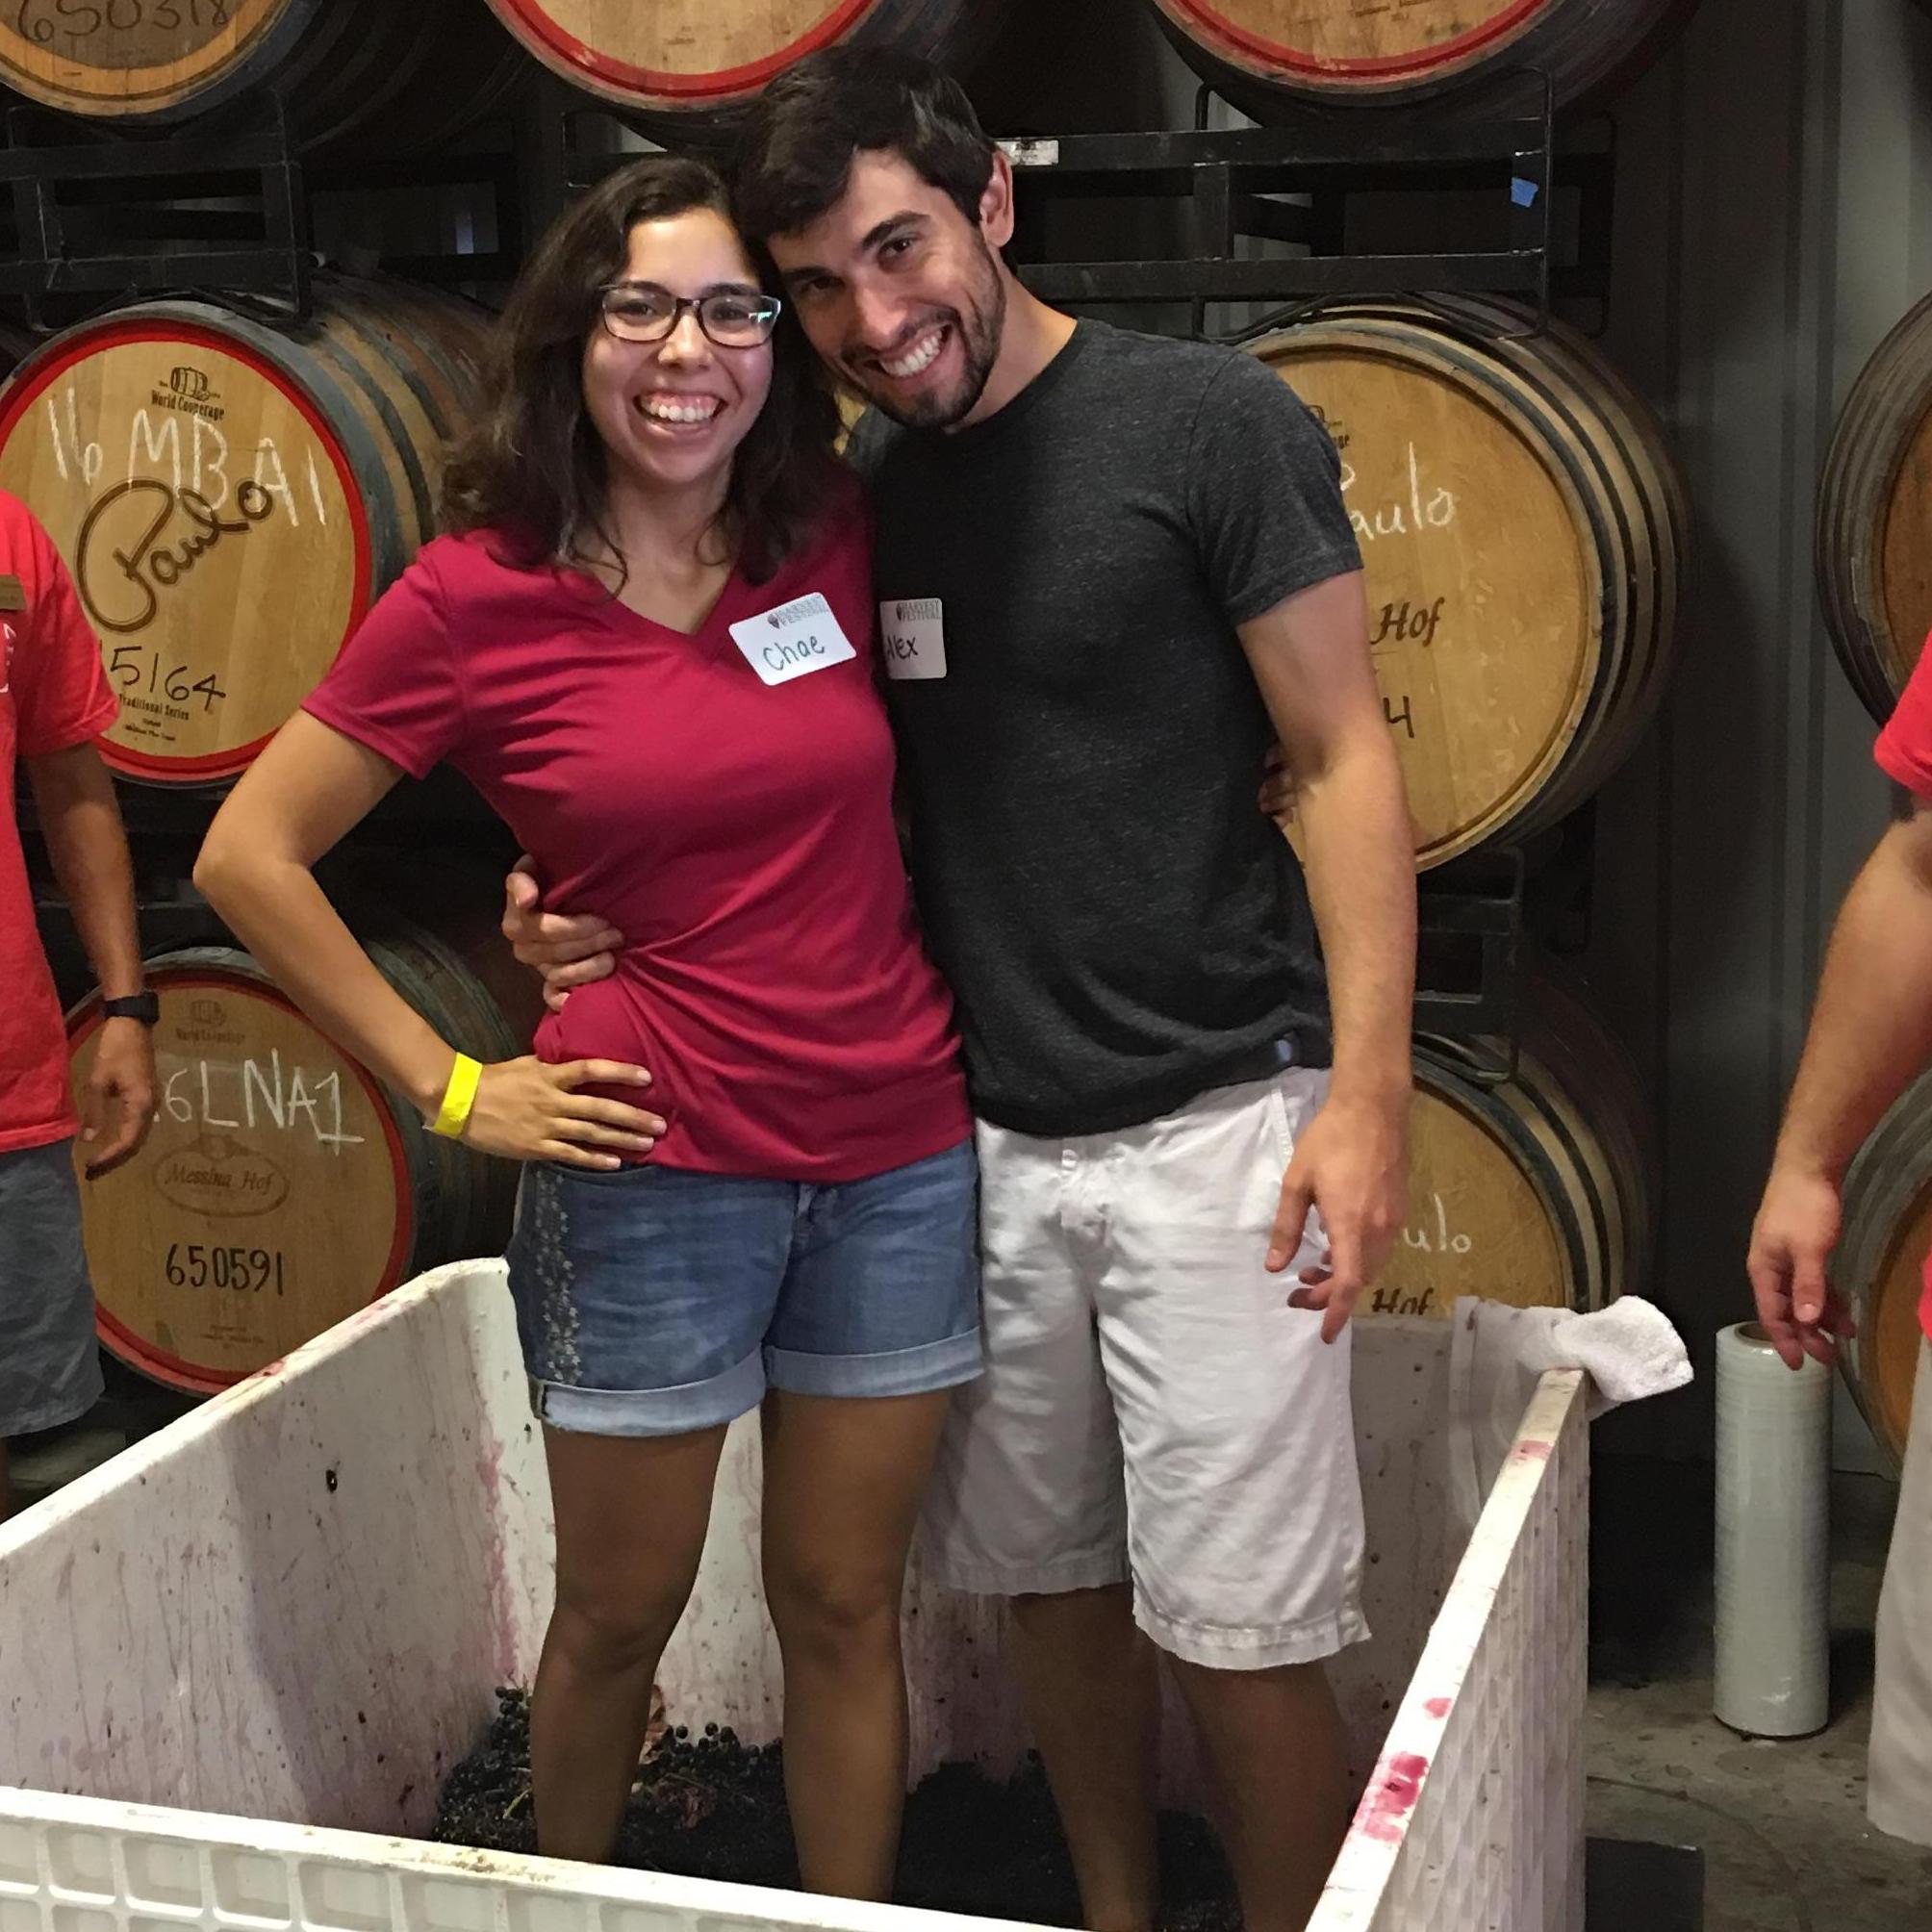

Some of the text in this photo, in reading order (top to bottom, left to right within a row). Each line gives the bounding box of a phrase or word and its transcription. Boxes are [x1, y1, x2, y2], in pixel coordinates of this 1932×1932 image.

[48, 387, 103, 486] 16
[1347, 441, 1456, 541] aulo
[76, 477, 274, 633] Paulo
[763, 635, 826, 671] Chae
[1370, 597, 1445, 648] Hof
[99, 639, 226, 712] 5164
[1403, 1192, 1472, 1253] ulo
[165, 1244, 284, 1296] 650591
